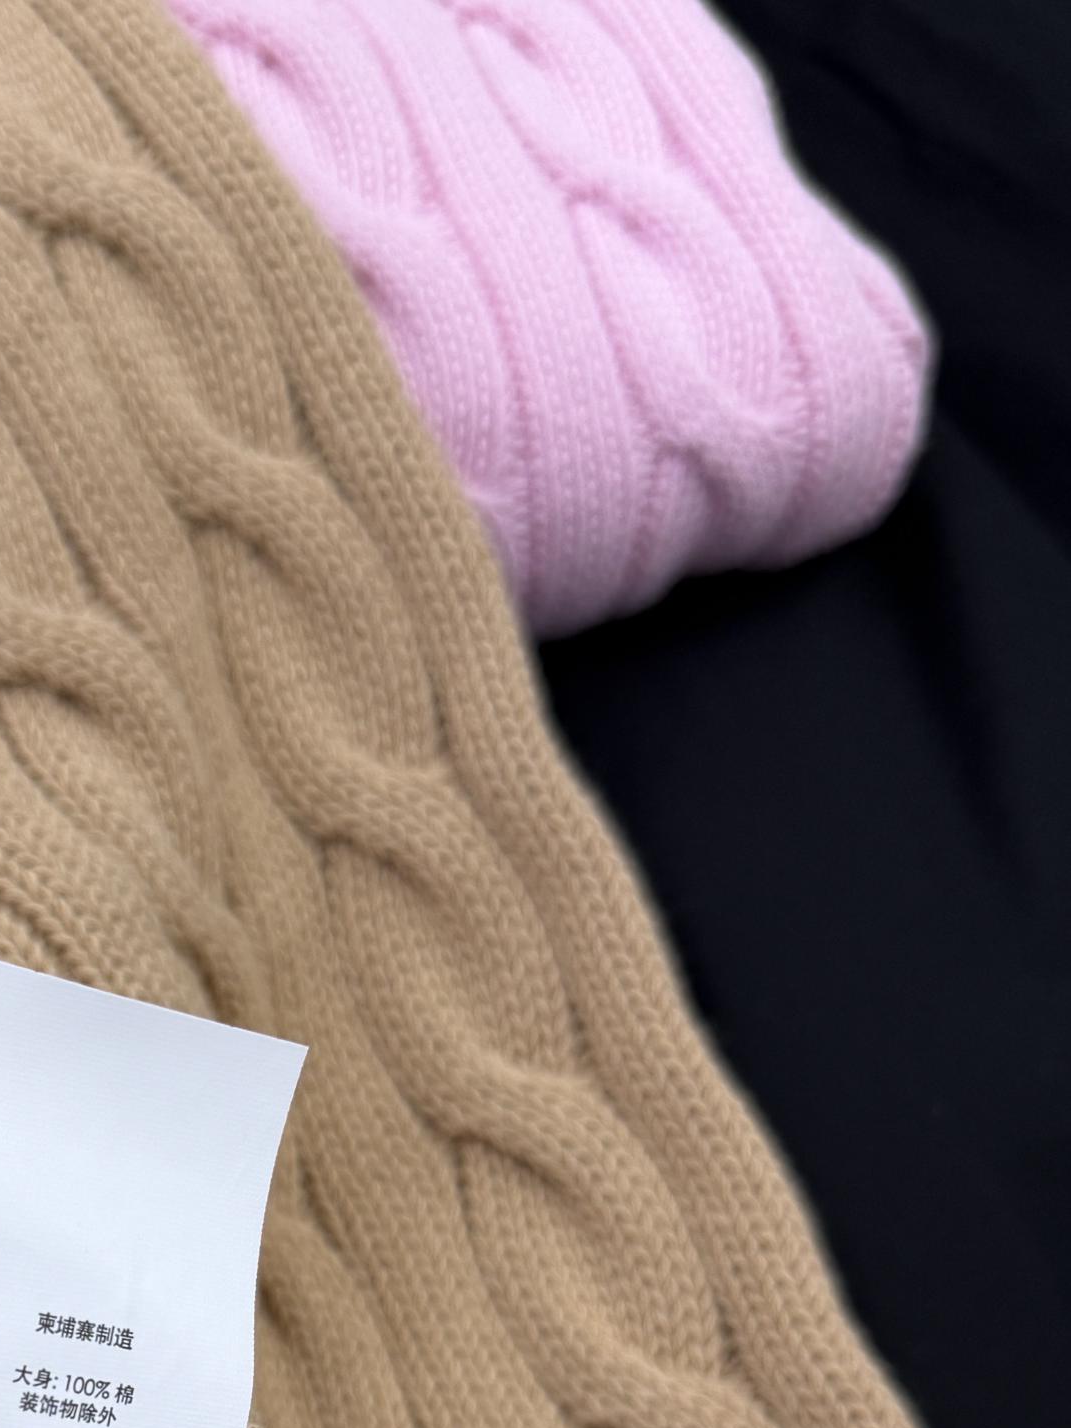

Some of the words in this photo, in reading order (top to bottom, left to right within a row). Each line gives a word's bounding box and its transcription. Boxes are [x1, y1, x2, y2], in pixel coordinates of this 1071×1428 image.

[35, 1312, 135, 1350] 柬埔寨制造
[12, 1365, 59, 1390] 大身:
[65, 1374, 111, 1399] 100%
[114, 1383, 135, 1405] 棉
[19, 1391, 117, 1427] 装饰物除外
